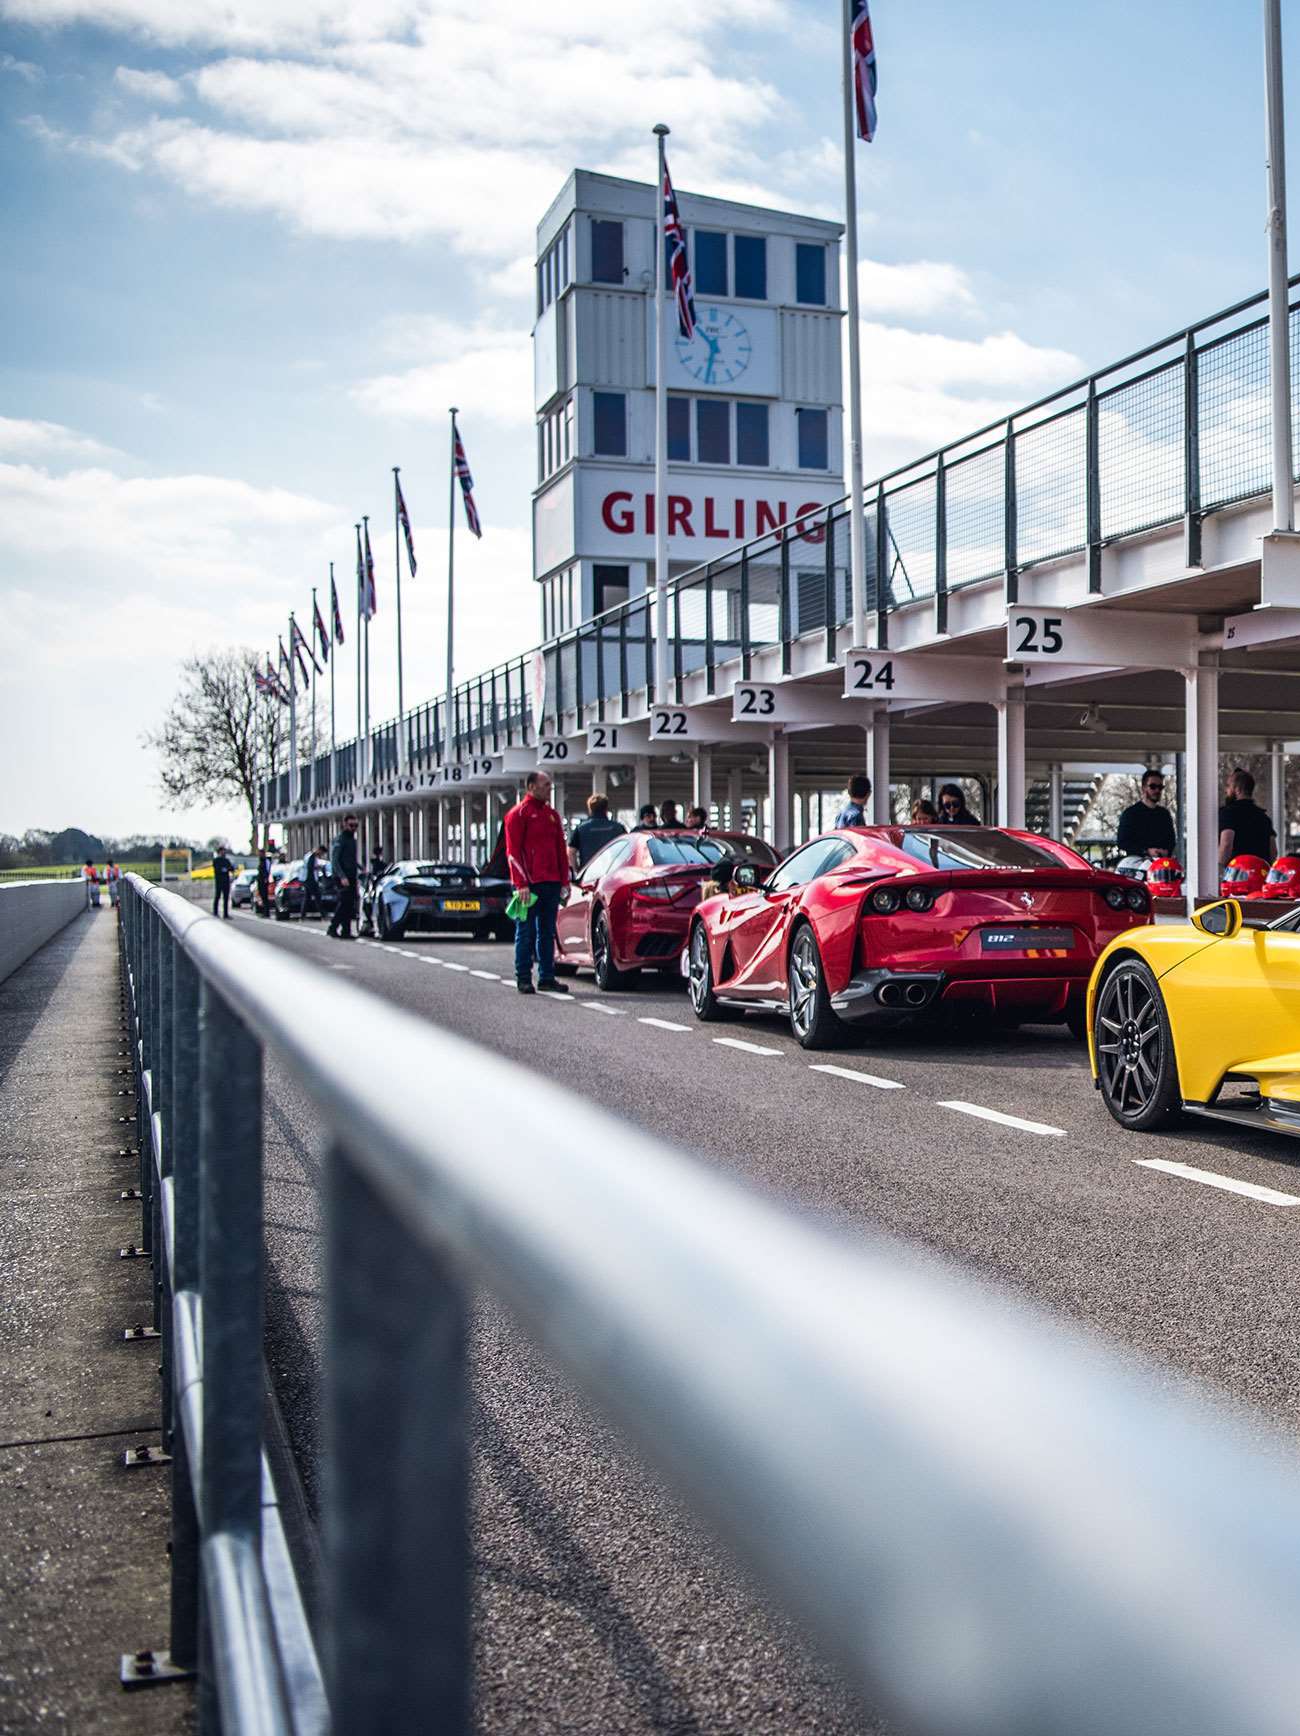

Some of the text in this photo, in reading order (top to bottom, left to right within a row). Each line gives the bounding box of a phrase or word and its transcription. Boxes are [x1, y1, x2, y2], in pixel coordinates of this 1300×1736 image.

[602, 491, 827, 544] GIRLING
[1015, 617, 1063, 654] 25
[853, 660, 896, 690] 24
[740, 689, 775, 715] 23
[656, 712, 688, 734] 22
[593, 729, 617, 748] 21
[542, 742, 568, 759] 20
[444, 768, 462, 781] 18
[473, 760, 492, 775] 19
[398, 780, 414, 792] 16
[420, 774, 436, 786] 17
[363, 788, 377, 799] 14
[380, 784, 395, 796] 15
[988, 935, 1014, 943] 812
